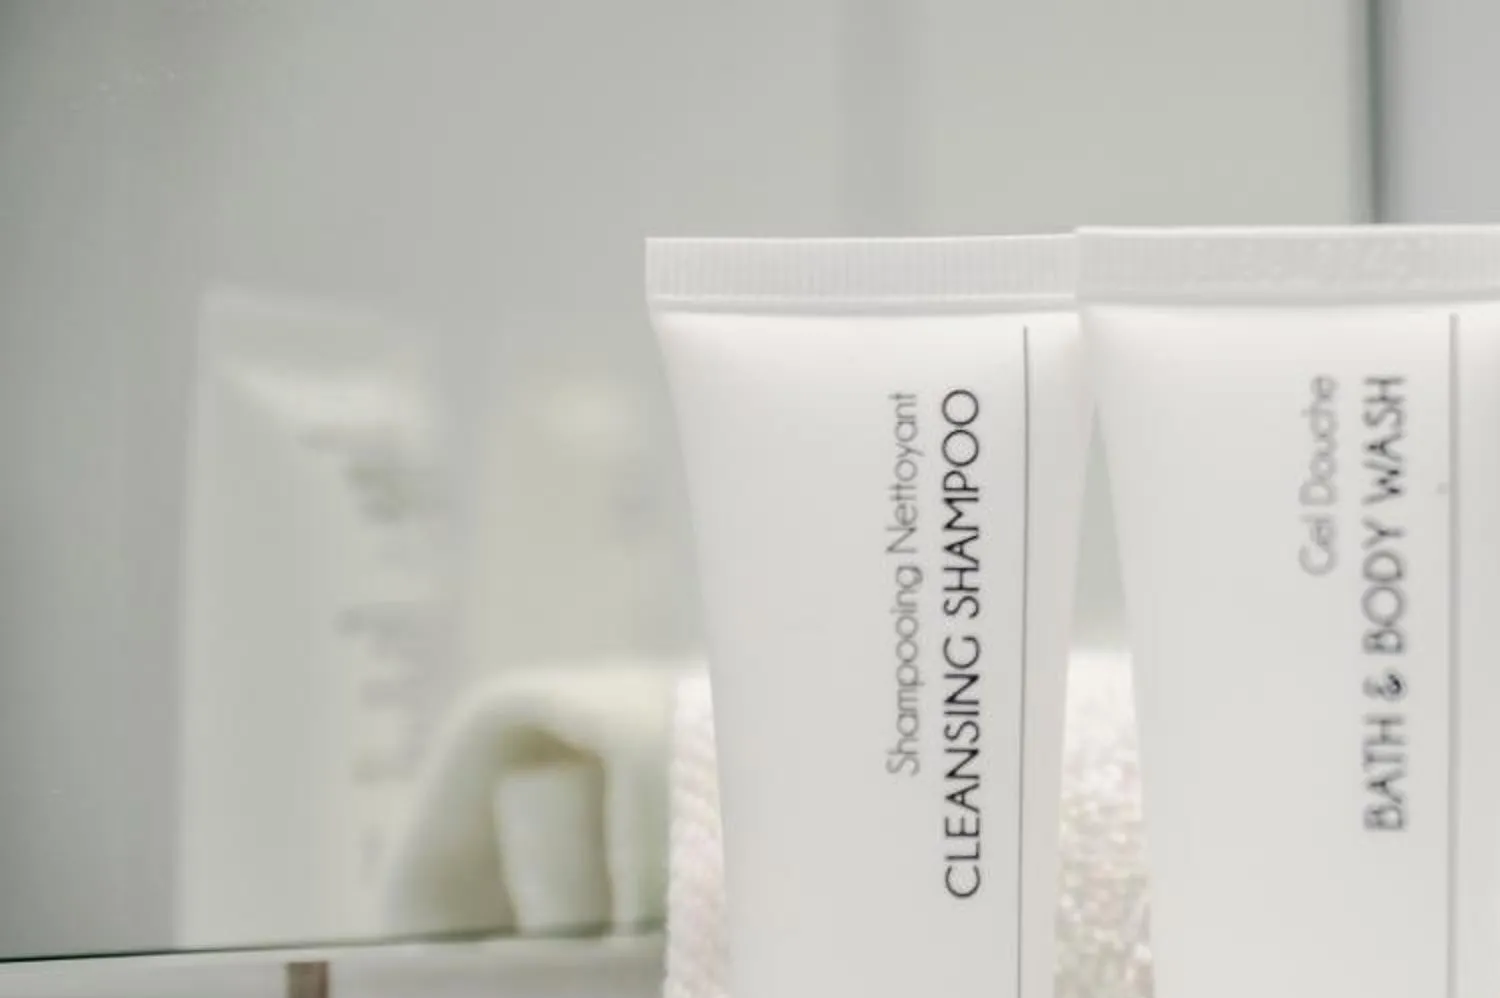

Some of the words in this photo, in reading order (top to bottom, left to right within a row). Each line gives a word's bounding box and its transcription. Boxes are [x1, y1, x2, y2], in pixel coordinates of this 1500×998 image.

[885, 393, 923, 554] Nettoyant
[942, 390, 980, 618] SHAMPOO
[1299, 376, 1338, 505] Douche
[1365, 378, 1402, 503] WASH
[1299, 515, 1337, 576] Gel
[1362, 520, 1405, 654] BODY
[886, 565, 925, 776] Shampooing
[1361, 671, 1405, 702] &
[943, 636, 981, 898] CLEANSING
[1363, 716, 1405, 830] BATH
